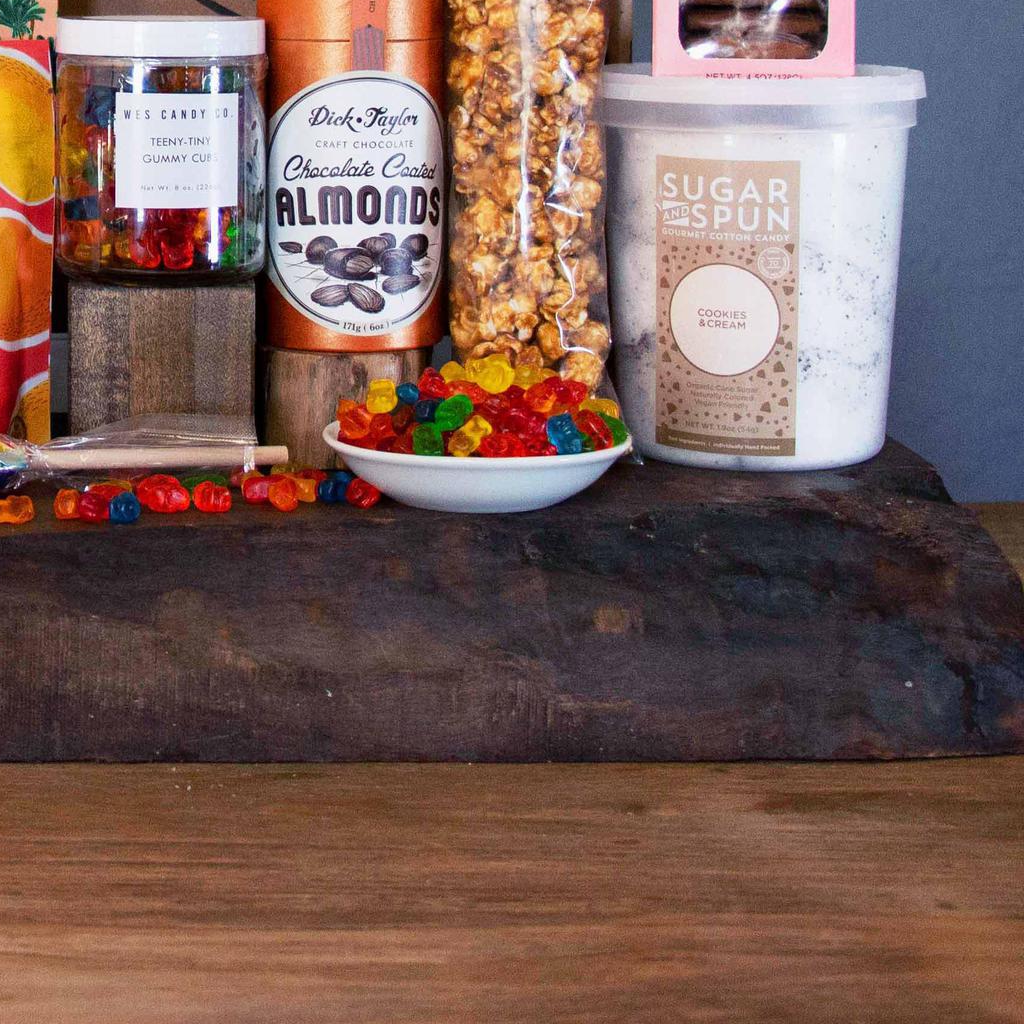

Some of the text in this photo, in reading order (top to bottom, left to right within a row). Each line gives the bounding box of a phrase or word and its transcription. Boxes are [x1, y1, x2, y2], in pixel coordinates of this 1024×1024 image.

[124, 109, 150, 120] WES
[161, 108, 206, 120] CANDY
[151, 136, 211, 146] TEENY-TINY
[315, 140, 413, 149] CRAFT CHOCOLATE
[142, 154, 188, 163] GUMMY
[284, 153, 436, 181] Chocolate Coated
[663, 172, 788, 204] SUGAR
[276, 185, 440, 226] ALMONDS
[663, 203, 790, 231] AND SPUN
[662, 227, 791, 242] GOURMET COTTON CANDY
[697, 308, 747, 319] COOKIES
